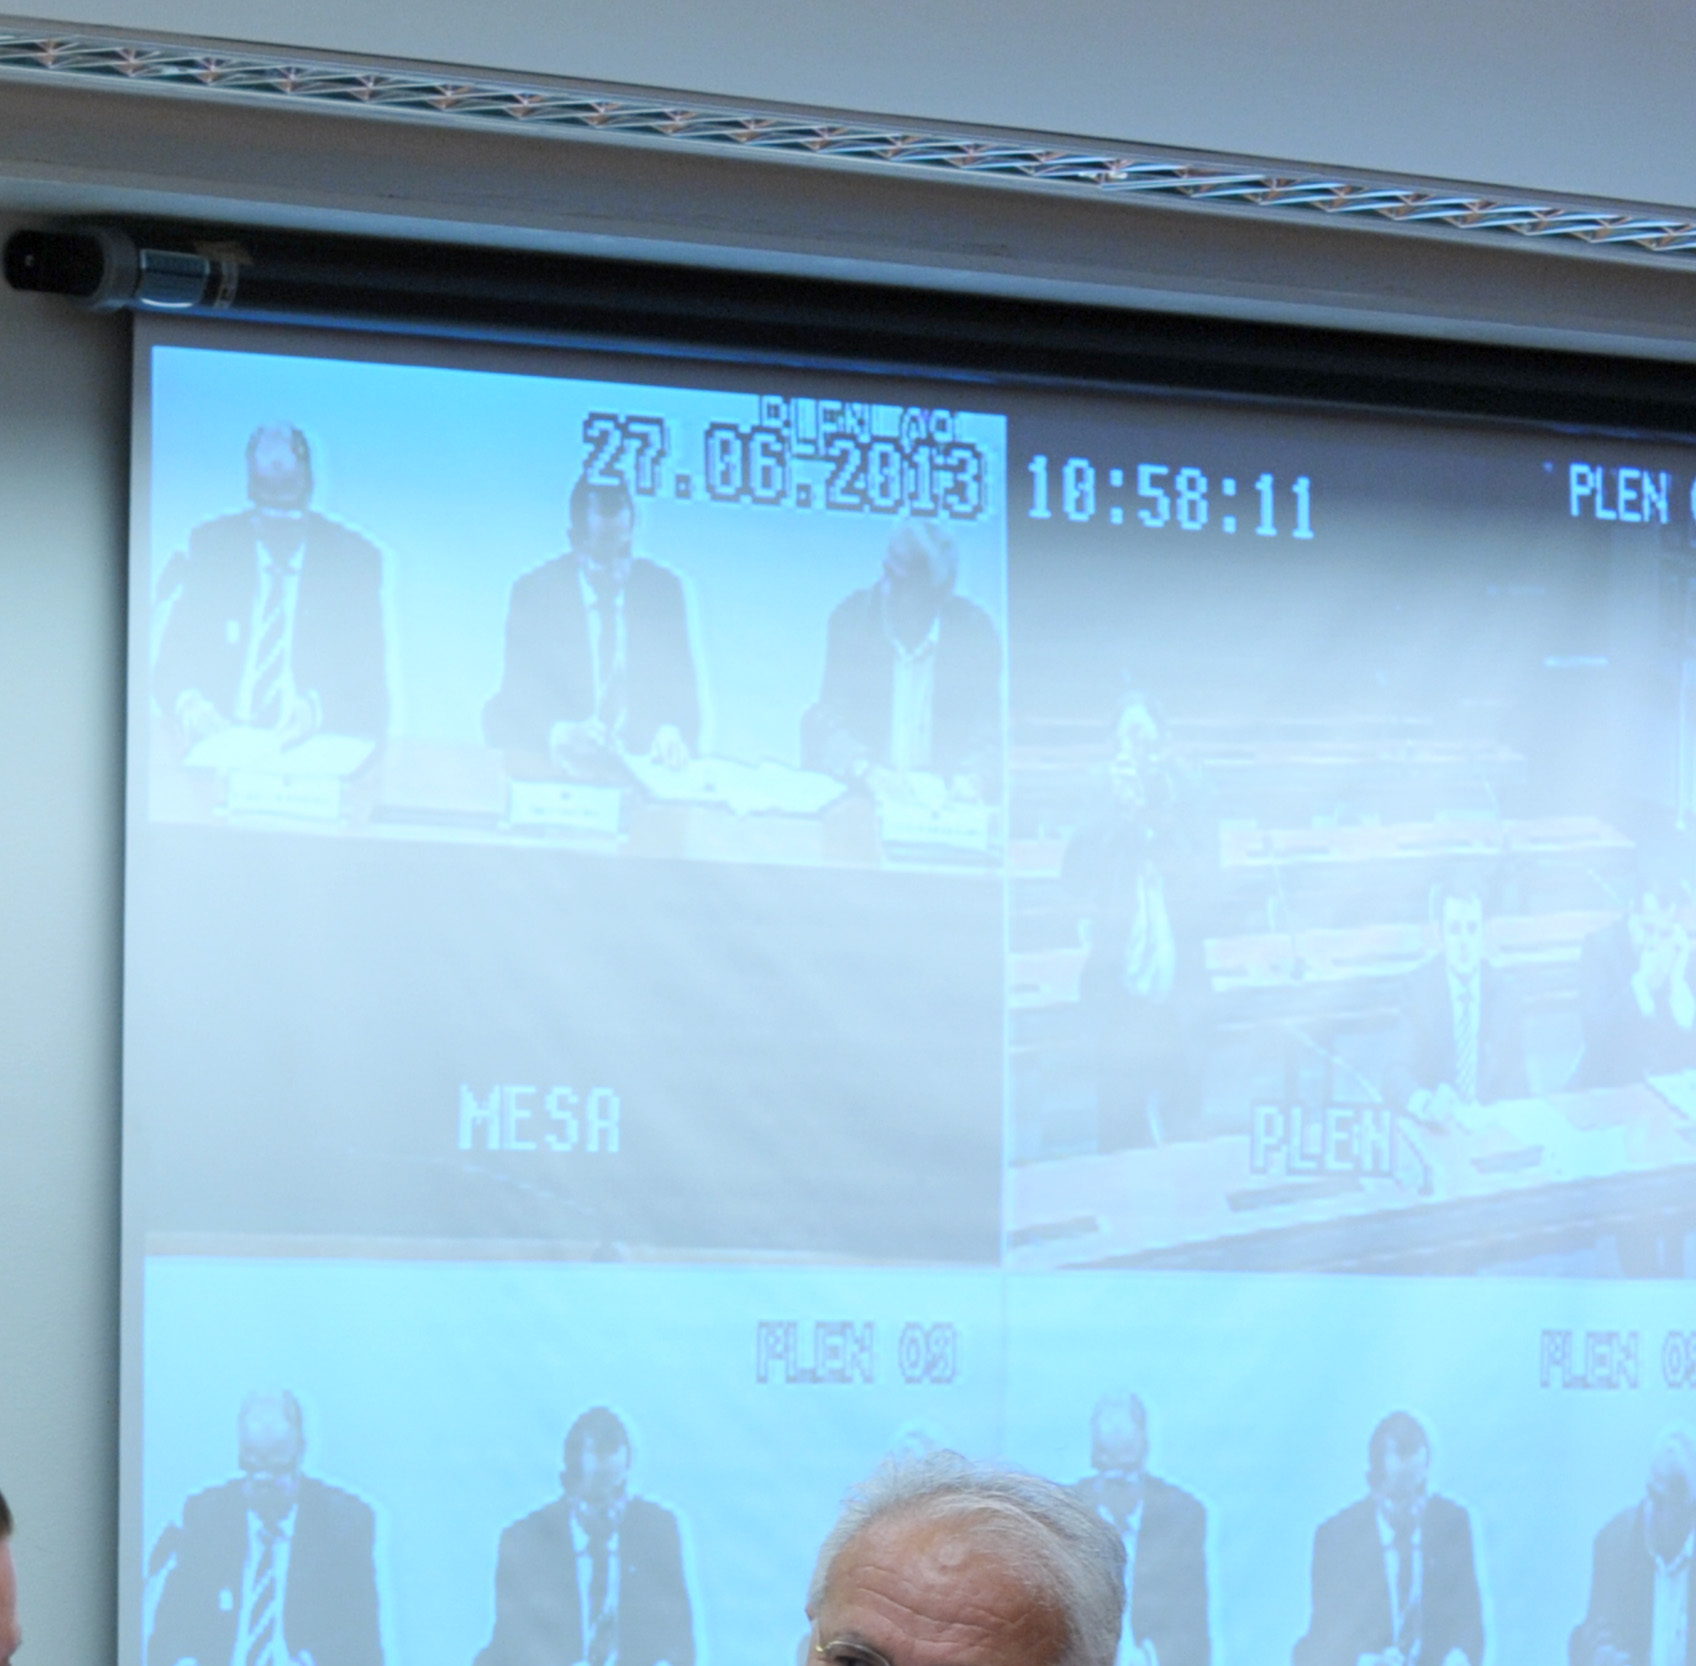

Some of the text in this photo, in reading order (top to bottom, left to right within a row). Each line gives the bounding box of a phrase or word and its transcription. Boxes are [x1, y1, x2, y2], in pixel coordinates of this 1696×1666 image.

[584, 414, 986, 518] 27.06.2013
[1028, 455, 1314, 539] 10:58:11
[1569, 463, 1669, 524] PLEN
[458, 1083, 622, 1154] MESA
[1251, 1104, 1393, 1174] PLEN
[756, 1320, 874, 1384] PLEN
[1540, 1329, 1696, 1389] PLEN 0
